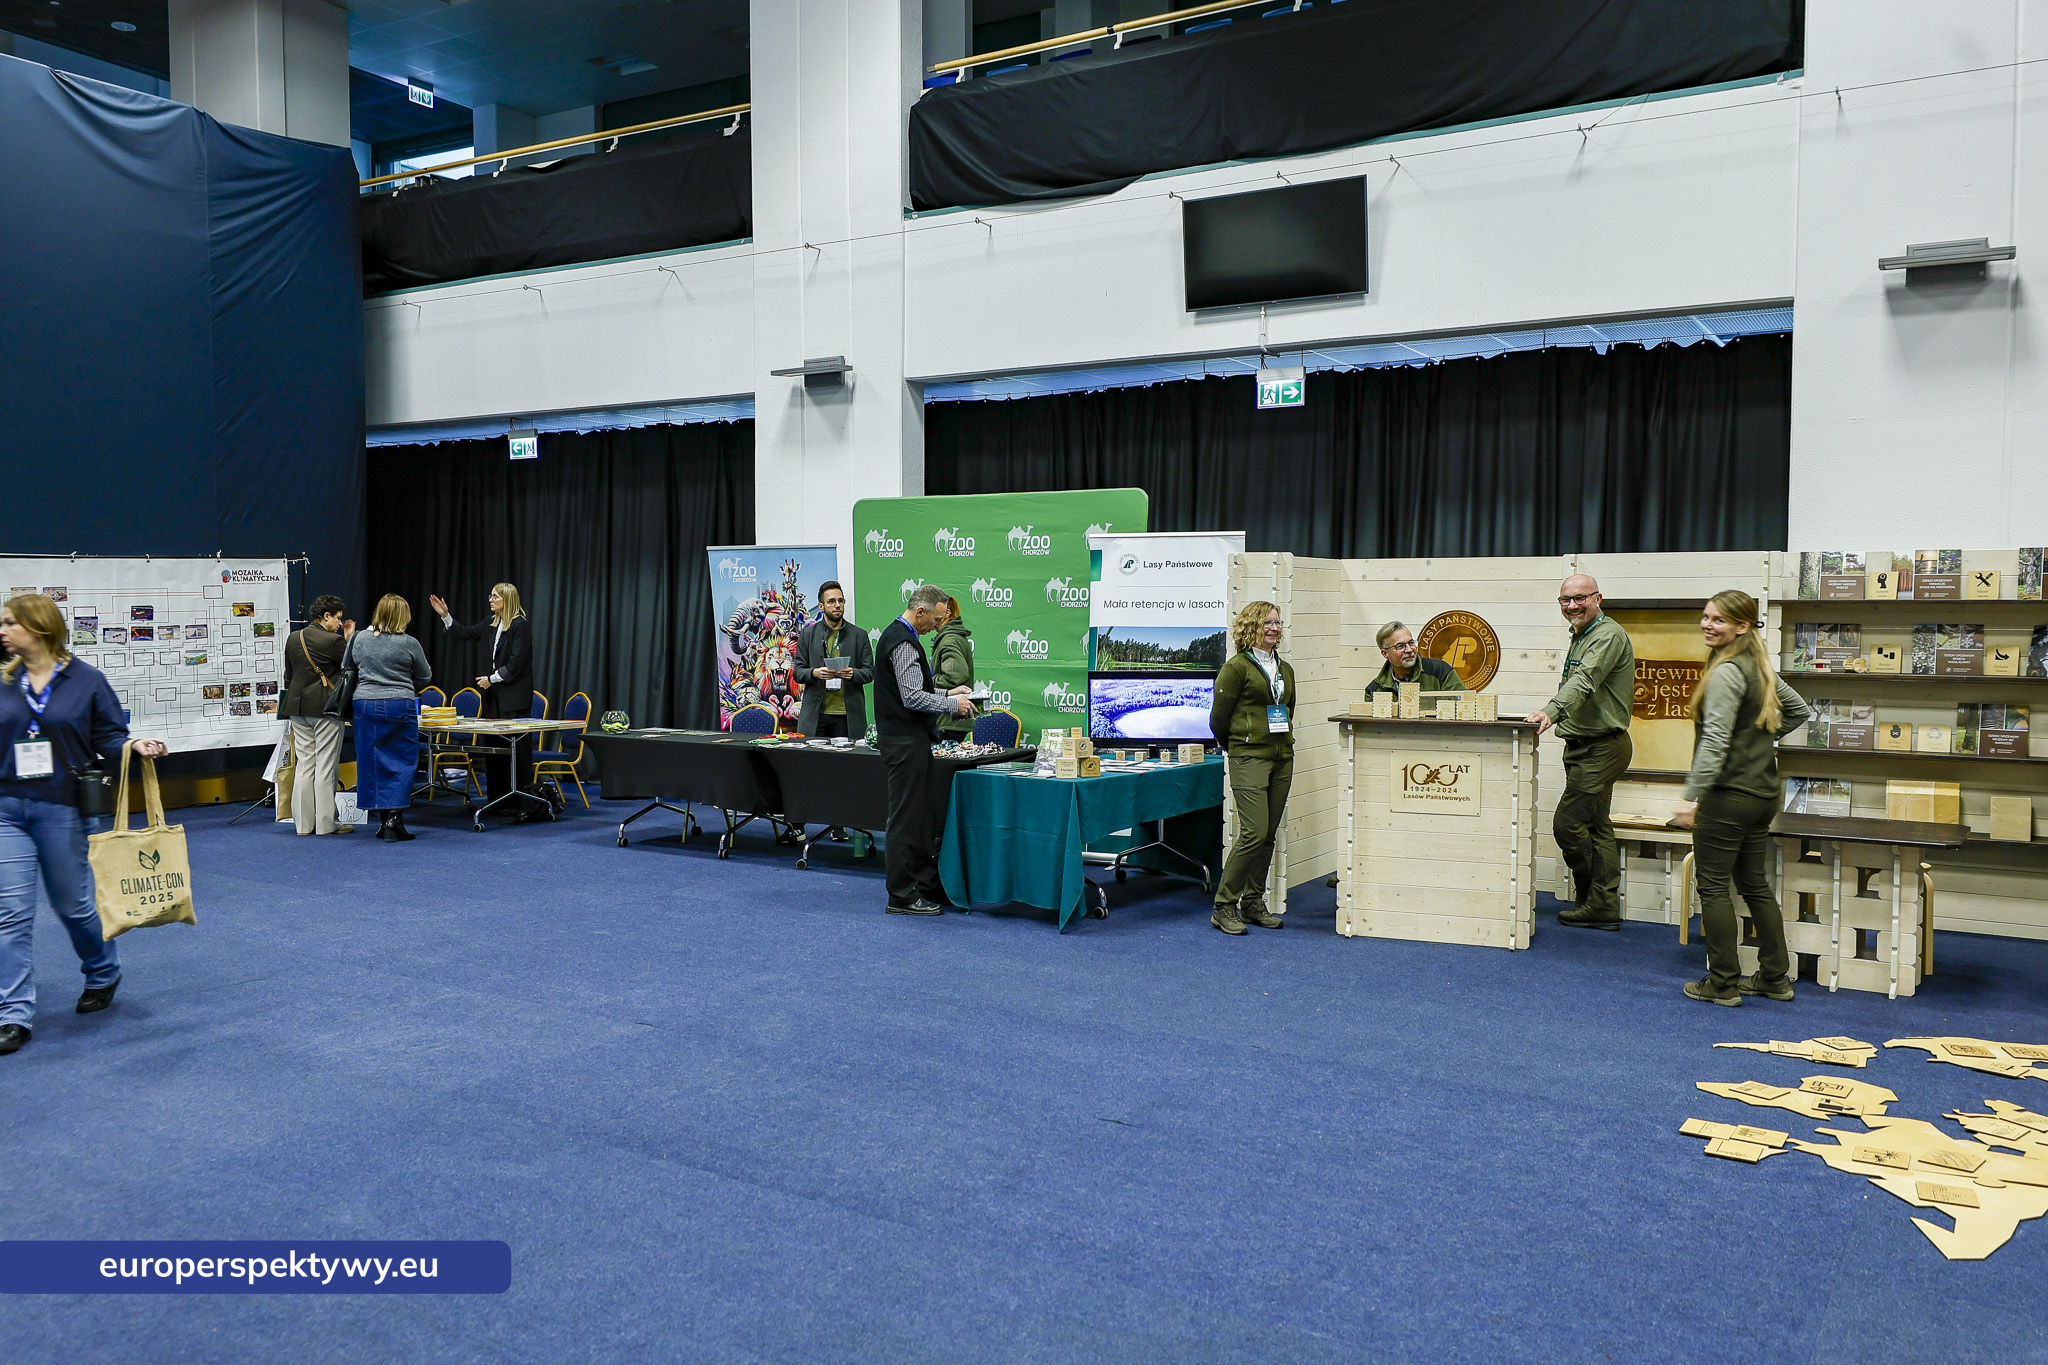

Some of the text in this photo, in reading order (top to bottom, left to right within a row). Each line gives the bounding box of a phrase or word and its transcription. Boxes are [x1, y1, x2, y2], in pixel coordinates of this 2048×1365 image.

[878, 538, 904, 551] ZOO
[948, 536, 976, 550] ZOO
[1022, 534, 1050, 549] ZOO
[1022, 548, 1050, 556] CHORZÓW
[732, 566, 757, 577] ZOO
[1143, 560, 1213, 570] Lasy Państwowe
[985, 587, 1013, 600] ZOO
[1061, 587, 1089, 600] ZOO
[985, 600, 1013, 608] CHORZÓW
[1103, 599, 1225, 612] Mała retencja w lasach
[1421, 614, 1495, 652] LASY PAŃSTWOWE
[1021, 639, 1049, 653] ZOO
[1651, 680, 1690, 702] jest
[1058, 692, 1086, 706] ZOO
[1647, 704, 1657, 716] z
[1449, 764, 1471, 774] LAT
[1425, 794, 1471, 802] Państwowych
[120, 872, 184, 895] CLIMATE-CON
[140, 891, 175, 906] 2025
